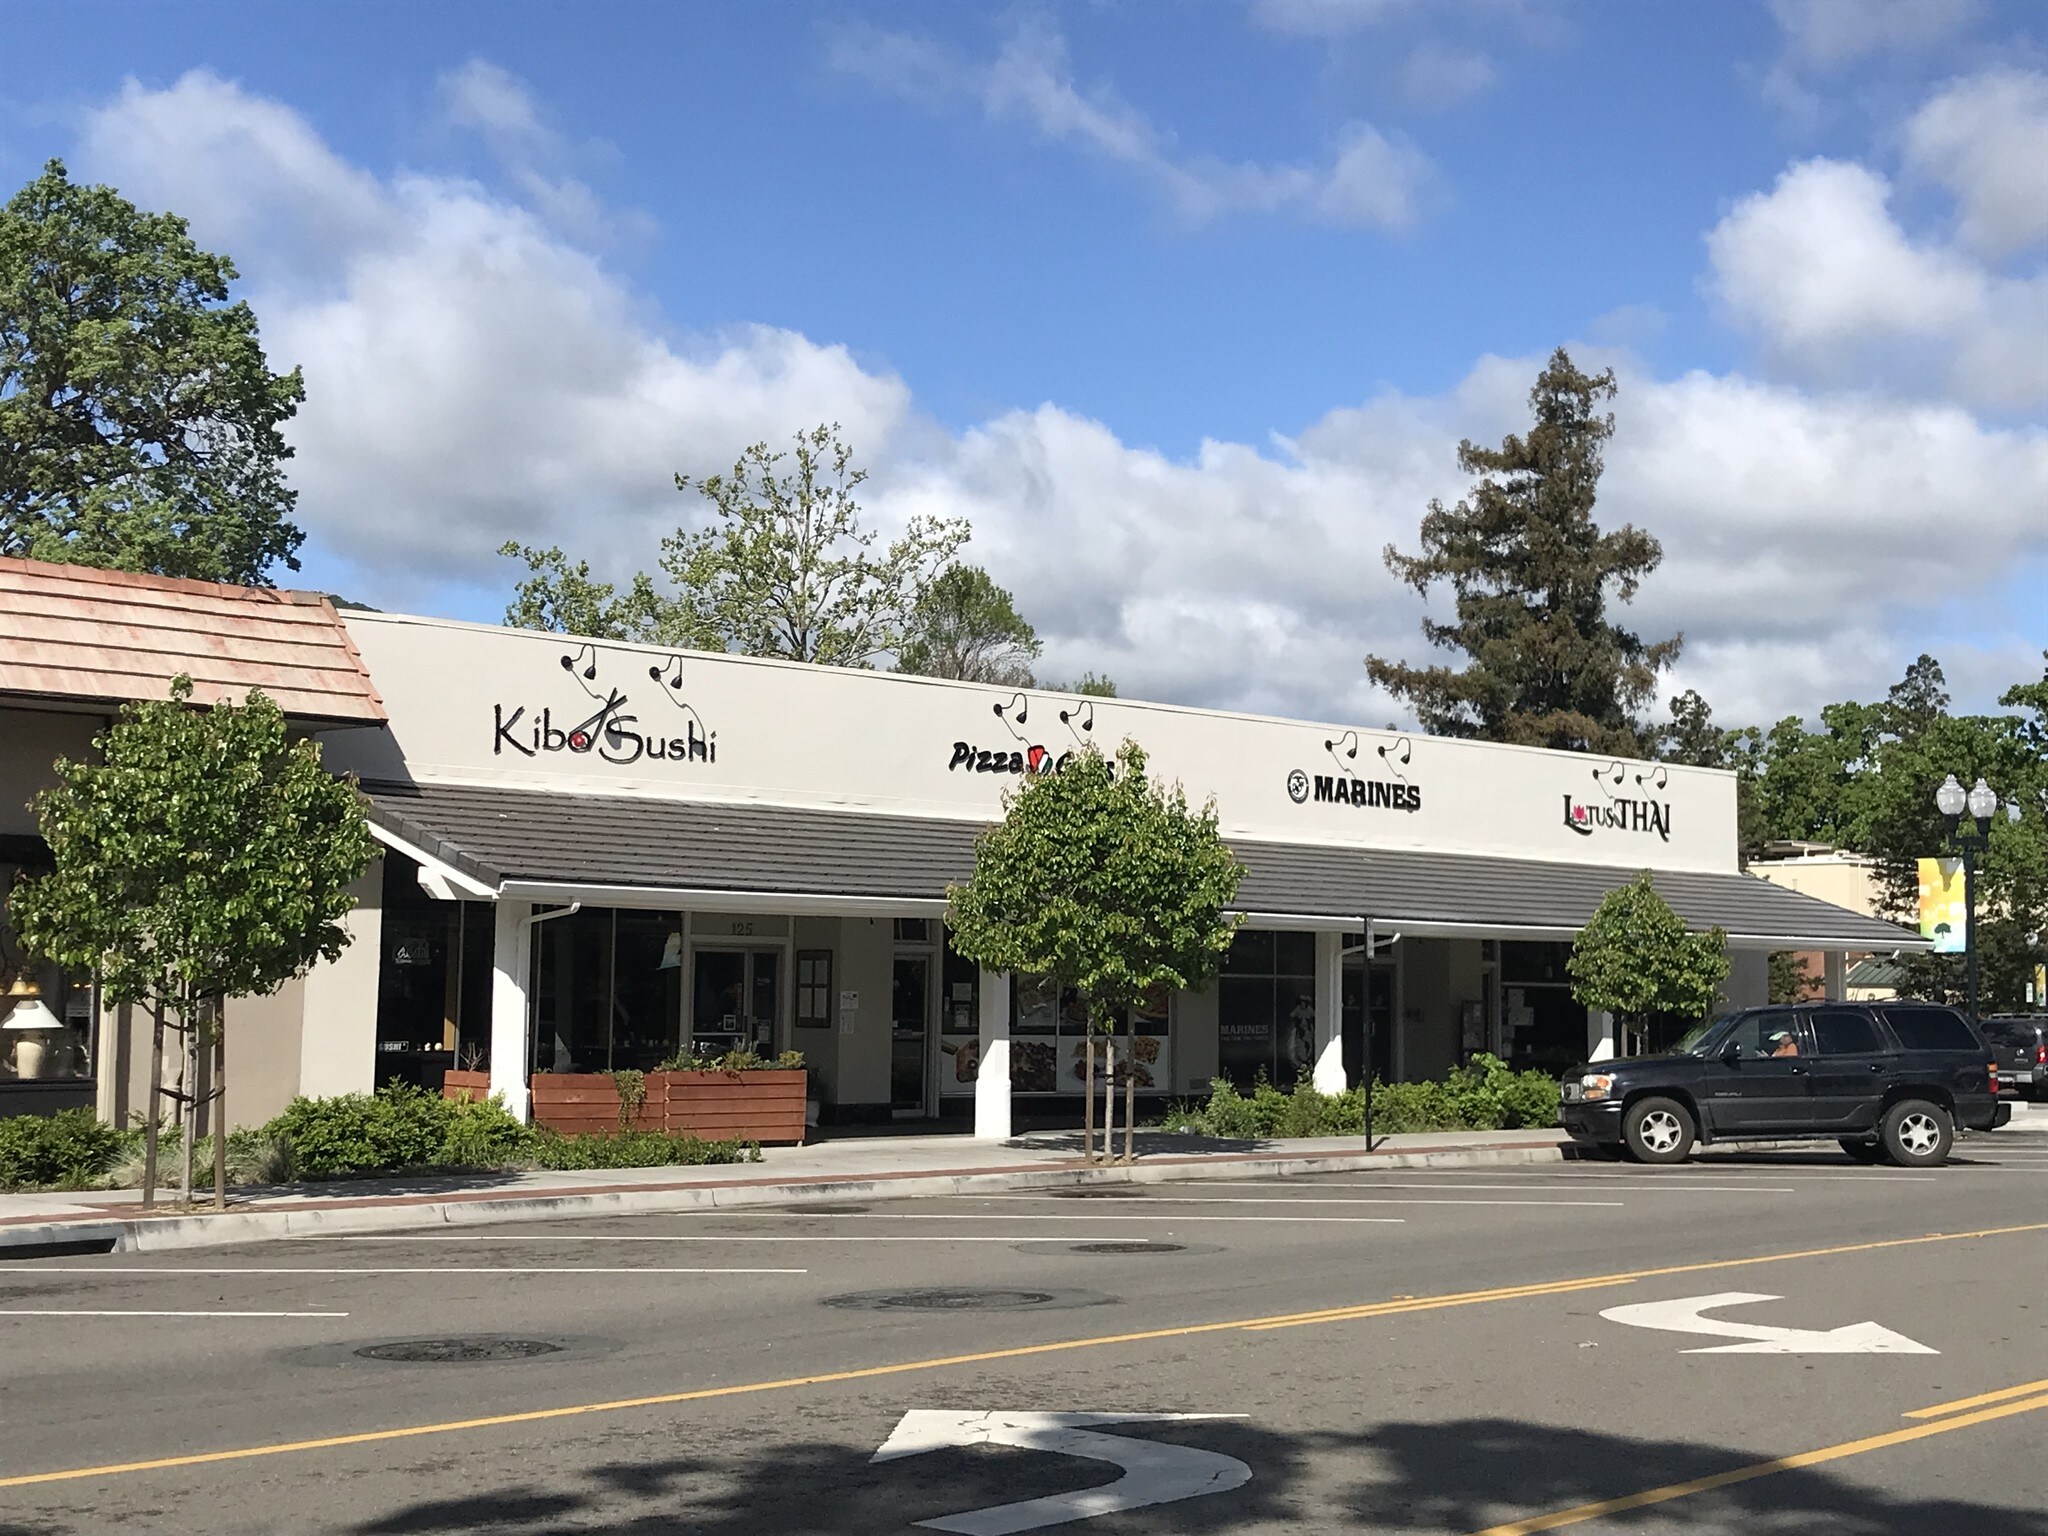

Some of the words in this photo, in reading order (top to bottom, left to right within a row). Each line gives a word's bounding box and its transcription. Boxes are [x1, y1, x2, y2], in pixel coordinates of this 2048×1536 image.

[494, 703, 591, 757] Kibo
[599, 715, 717, 764] Sushi
[949, 741, 1025, 774] Pizza
[1314, 775, 1421, 812] MARINES
[1613, 798, 1671, 842] THAI
[732, 922, 753, 936] 125
[1219, 1024, 1269, 1035] MARINES
